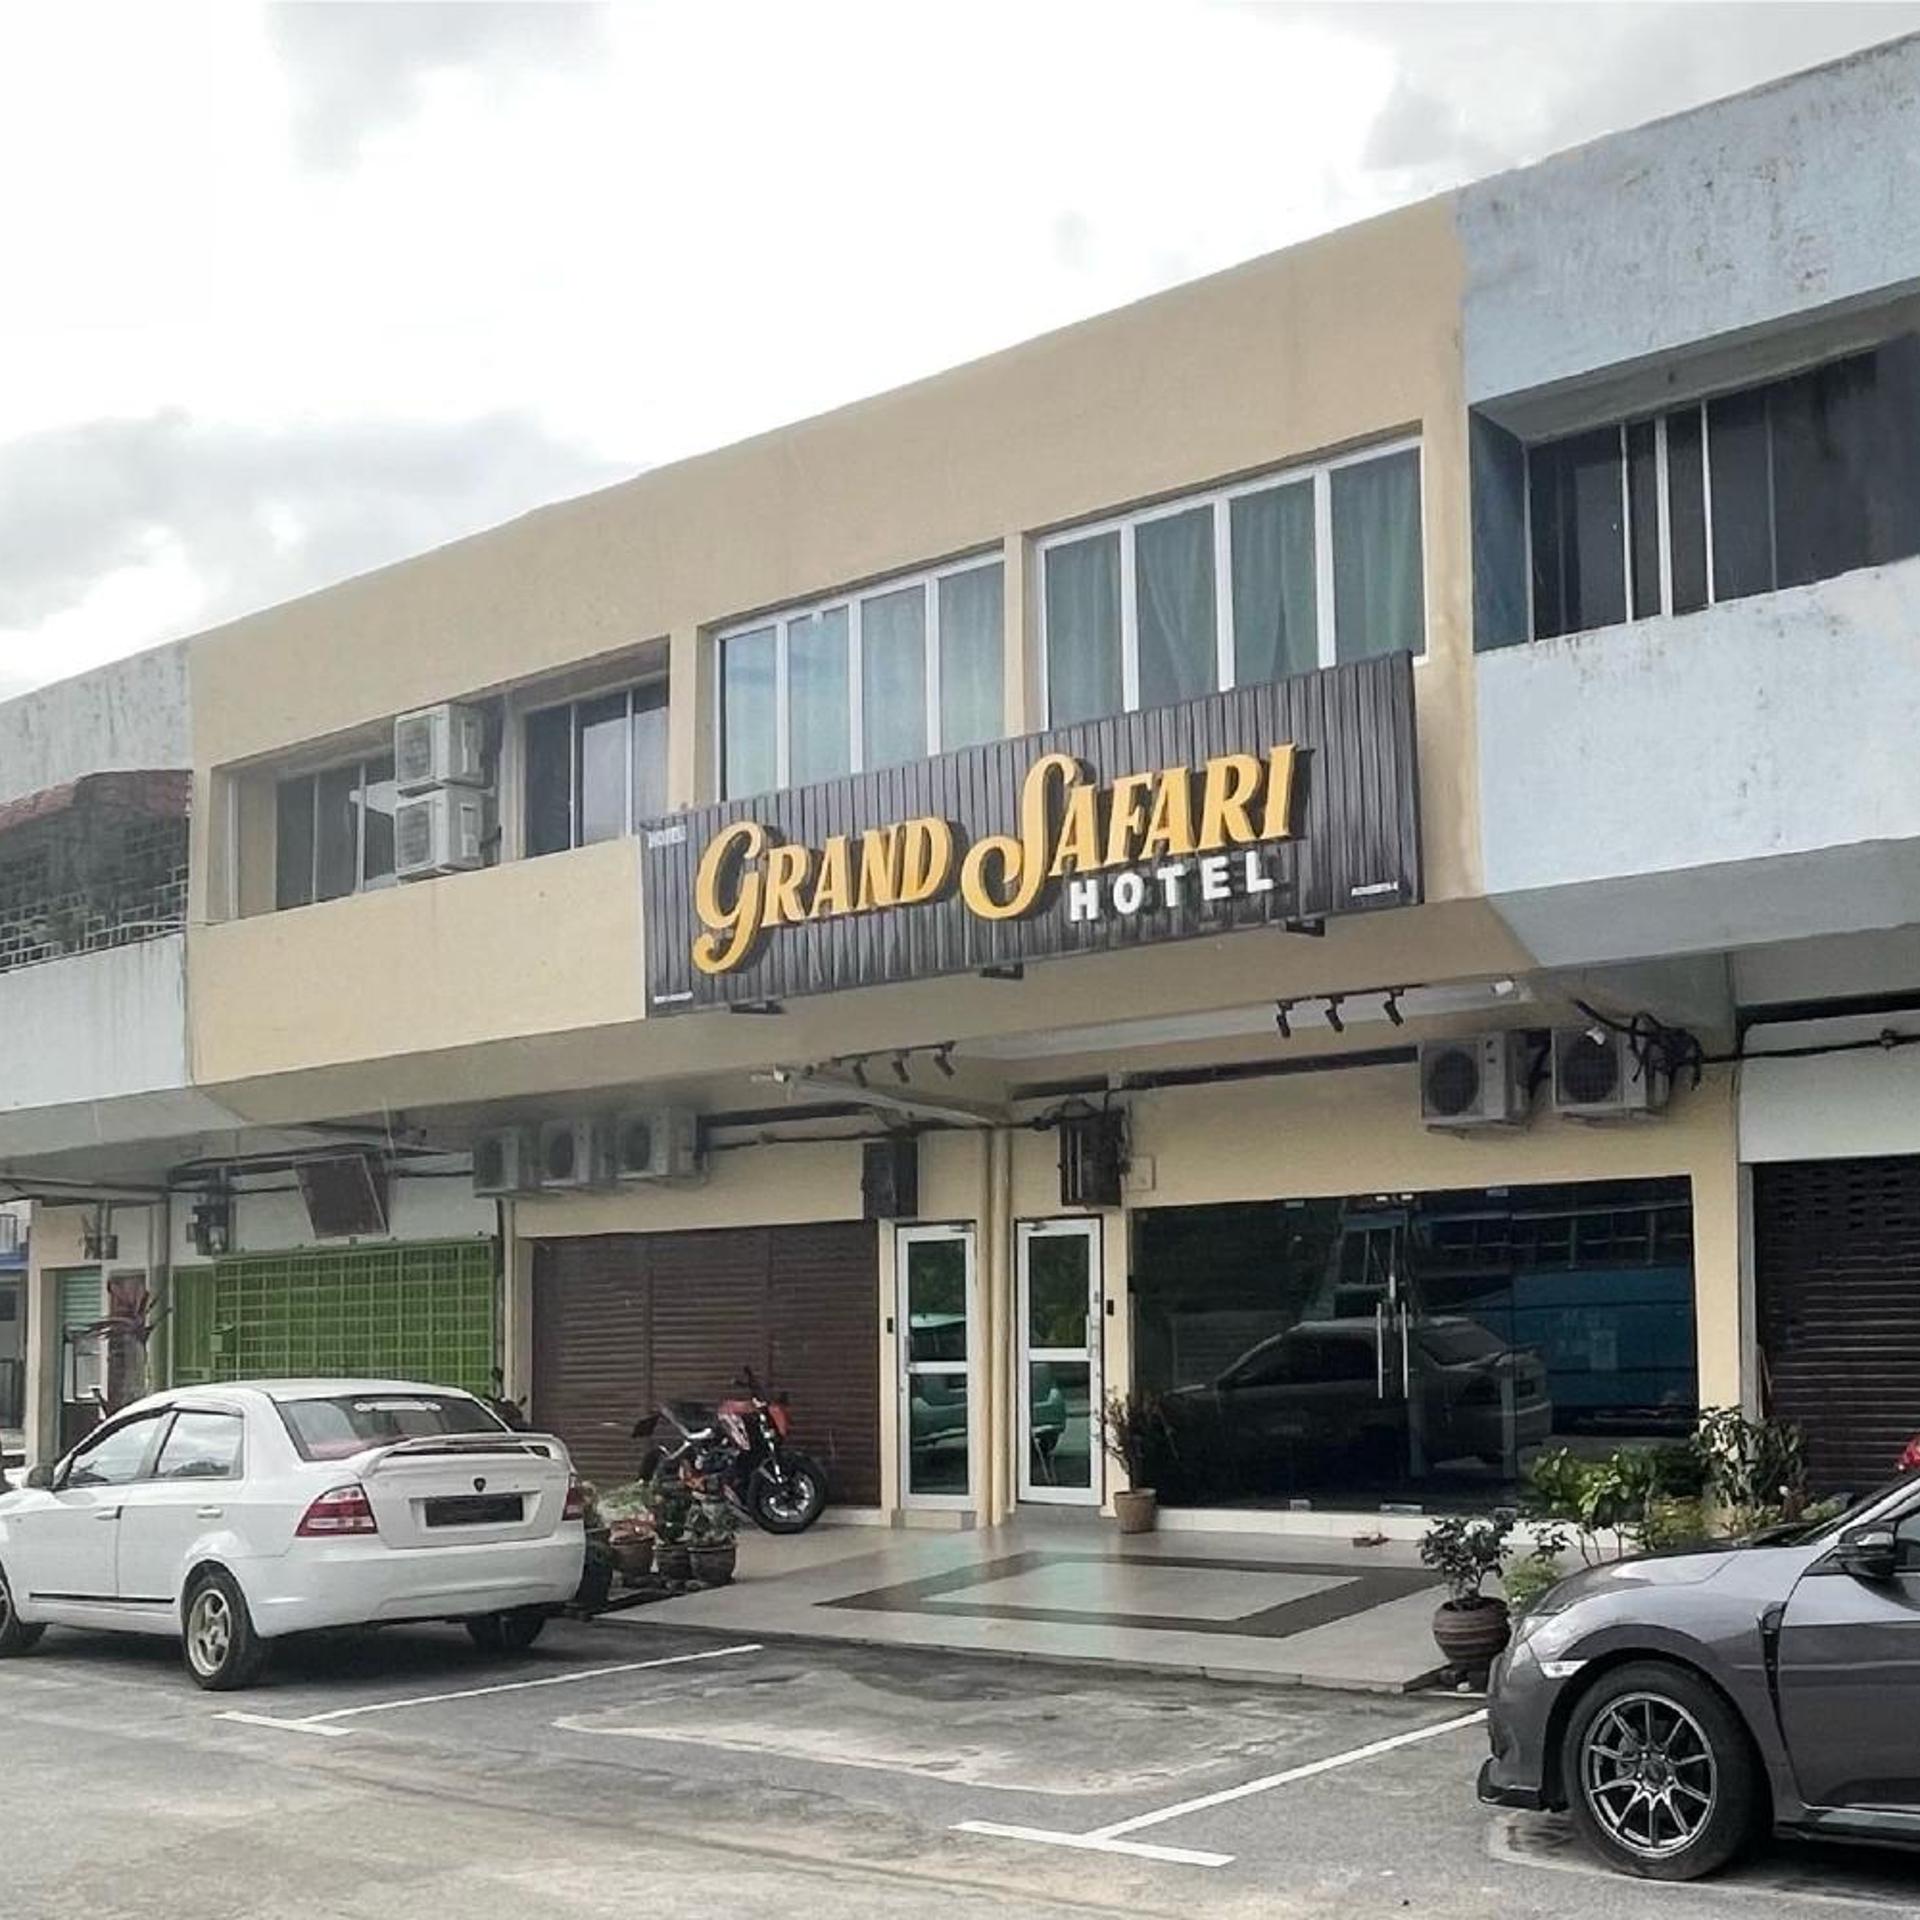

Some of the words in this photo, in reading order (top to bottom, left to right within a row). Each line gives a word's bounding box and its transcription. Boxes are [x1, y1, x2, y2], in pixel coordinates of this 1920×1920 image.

[692, 817, 955, 974] GRAND
[961, 743, 1297, 920] SAFARI
[1070, 851, 1273, 922] HOTEL
